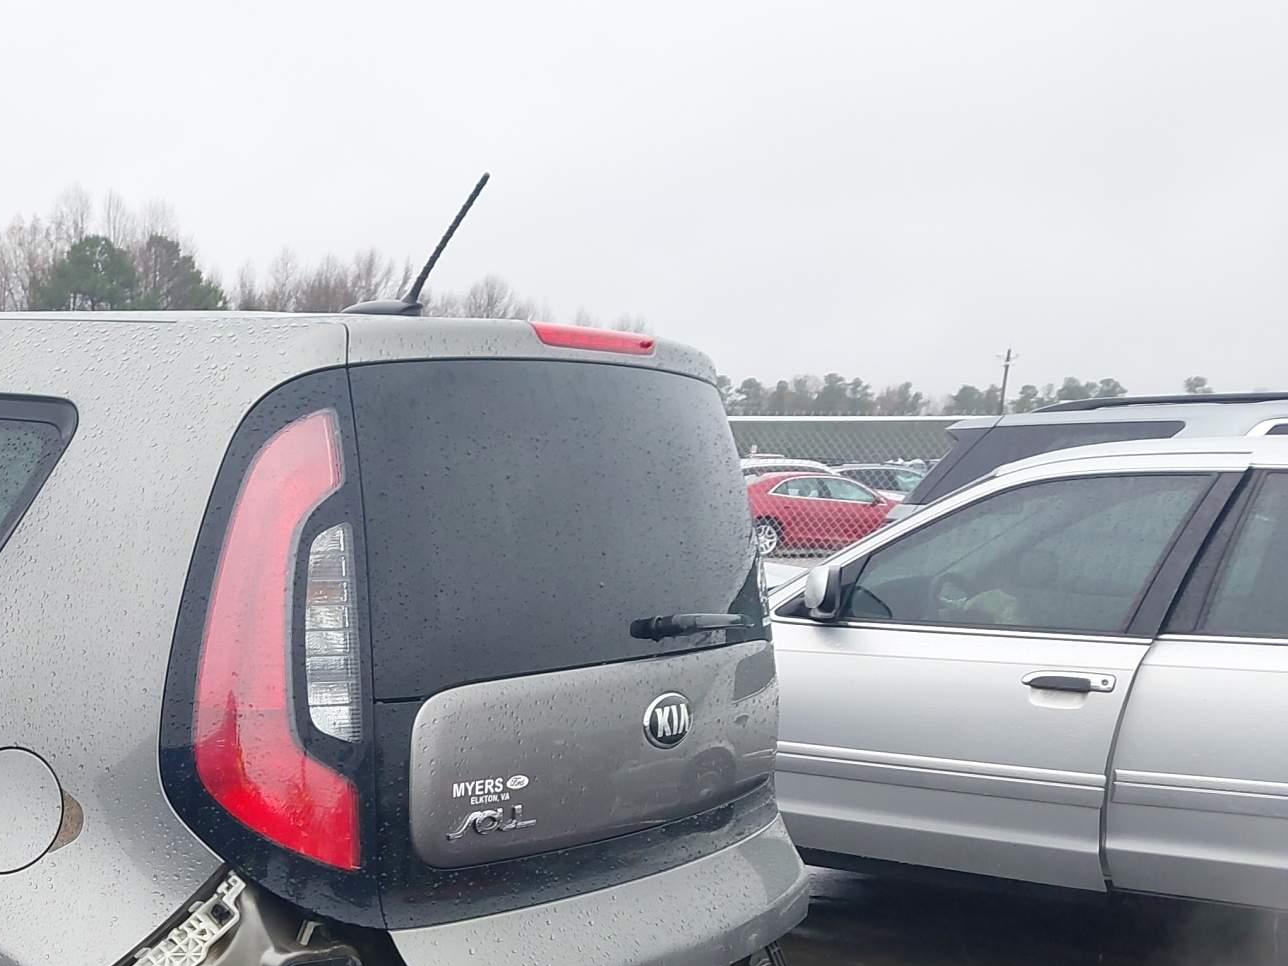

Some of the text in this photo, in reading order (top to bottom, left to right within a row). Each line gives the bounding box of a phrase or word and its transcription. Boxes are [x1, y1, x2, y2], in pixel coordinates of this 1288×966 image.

[654, 703, 690, 738] KIA
[452, 777, 504, 798] MYERS
[470, 792, 510, 805] ELKTON, VA
